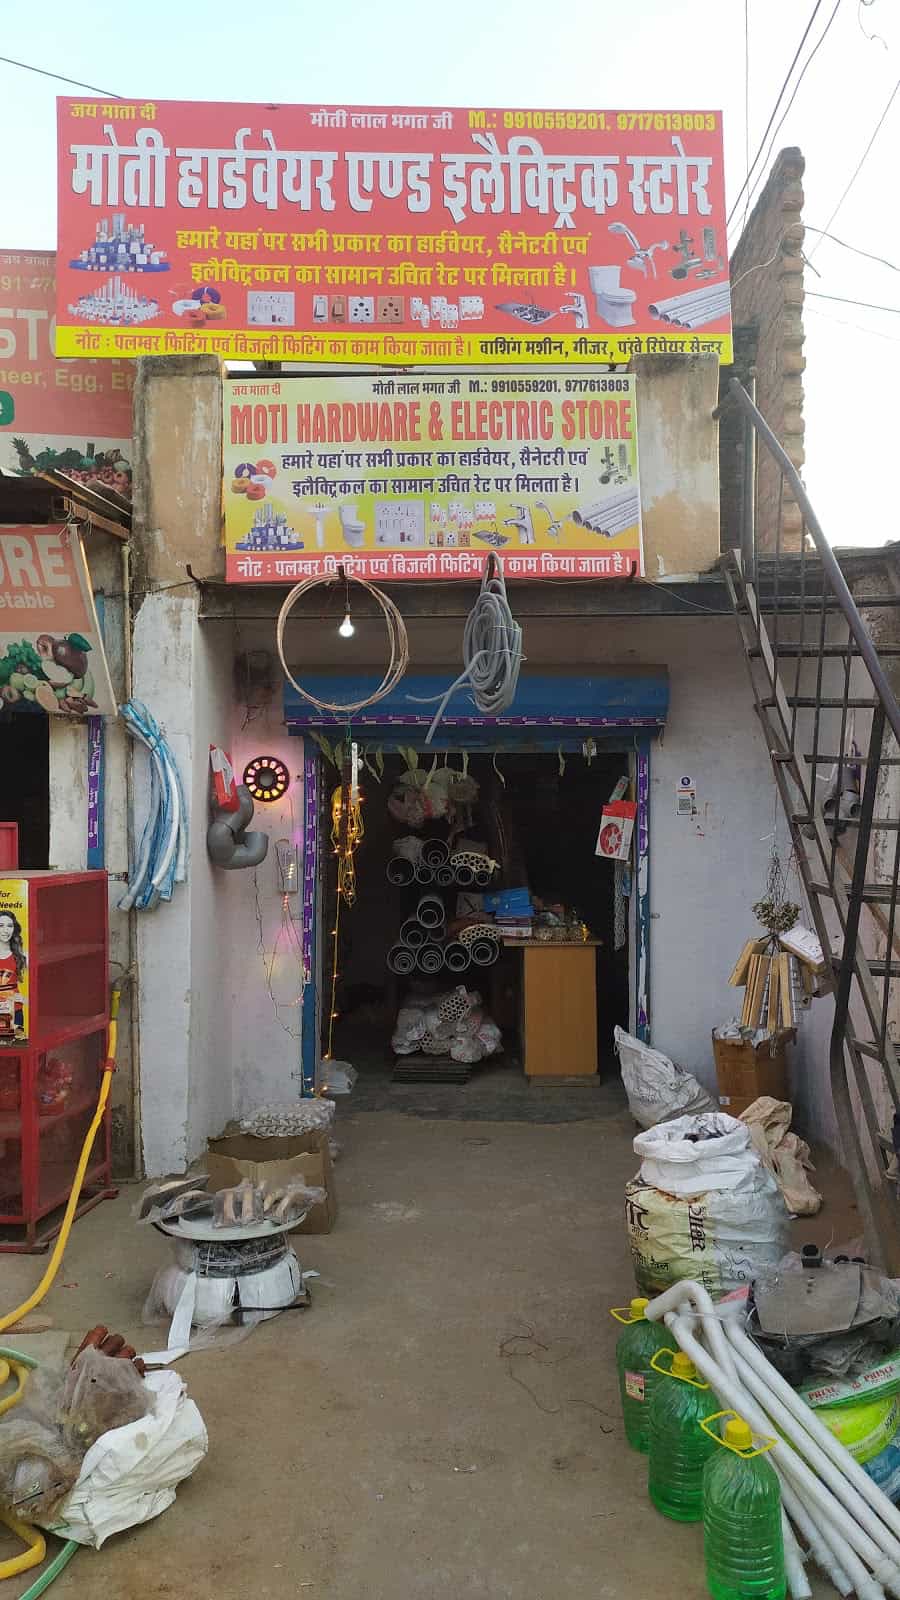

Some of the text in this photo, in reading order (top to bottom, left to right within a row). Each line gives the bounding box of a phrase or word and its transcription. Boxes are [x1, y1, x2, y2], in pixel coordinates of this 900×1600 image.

[71, 102, 157, 120] जय माता दी
[310, 109, 348, 128] मोती
[350, 113, 388, 128] लाल
[431, 111, 453, 130] जी
[70, 124, 170, 208] मोती
[176, 128, 338, 211] हार्डवेयर
[345, 152, 434, 213] एण्ड
[626, 136, 713, 215] स्टोर
[176, 226, 221, 250] हमारे
[263, 233, 288, 251] पर
[291, 228, 331, 252] सभी
[332, 233, 383, 253] प्रकार
[386, 234, 413, 253] का
[560, 232, 593, 255] एवं
[294, 265, 321, 285] का
[324, 266, 384, 286] सामान
[387, 262, 433, 286] उचित
[435, 262, 460, 286] रेट
[463, 267, 489, 286] पर
[491, 262, 551, 287] मिलता
[114, 334, 161, 351] पलम्बर
[164, 331, 208, 353] फिटिंग
[211, 334, 233, 353] एवं
[234, 333, 280, 354] बिजली
[282, 335, 326, 355] फिटिंग
[328, 339, 348, 355] का
[350, 340, 381, 356] काम
[383, 336, 417, 356] किया
[419, 340, 452, 356] जाता
[479, 337, 522, 355] वाशिंग
[232, 382, 281, 396] जय माता दी
[372, 380, 395, 395] मोती
[397, 382, 420, 395] लाल
[446, 379, 461, 394] जी
[565, 379, 630, 393] 9717613803
[230, 400, 633, 445] MOTI HARDWARE & ELECTRIC STORE
[281, 450, 314, 469] हमारे
[345, 453, 363, 468] पर
[365, 449, 394, 468] सभी
[396, 451, 433, 467] प्रकार
[435, 452, 456, 466] का
[519, 446, 565, 466] सैनेटरी
[568, 447, 591, 466] एवं
[368, 479, 388, 494] का
[391, 478, 435, 494] सामान
[437, 473, 472, 493] उचित
[473, 473, 491, 493] रेट
[494, 477, 513, 492] पर
[514, 474, 560, 492] मिलता
[0, 535, 72, 587] RE
[275, 559, 320, 576] पलम्बर
[370, 555, 392, 574] एवं
[392, 553, 437, 574] बिजली
[439, 552, 483, 574] फिटिंग
[507, 556, 538, 573] काम
[540, 552, 577, 573] किया
[578, 556, 611, 573] जाता
